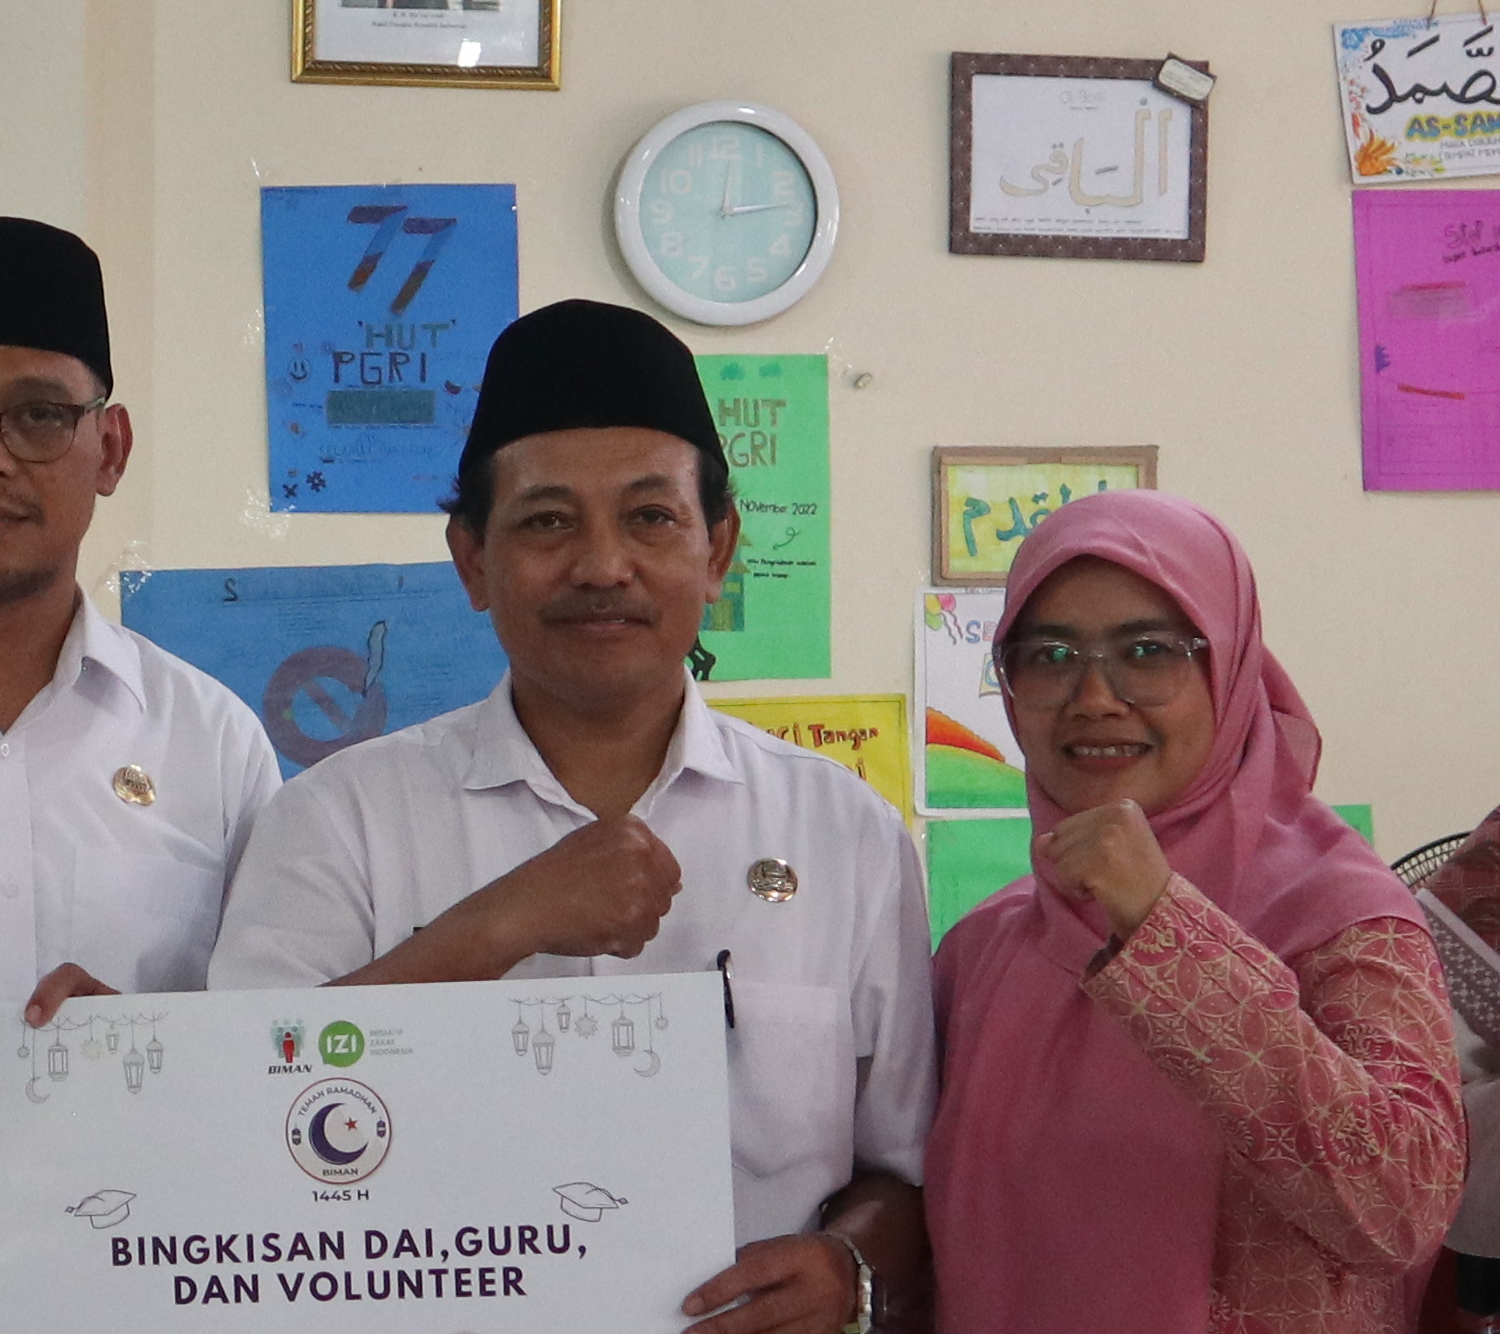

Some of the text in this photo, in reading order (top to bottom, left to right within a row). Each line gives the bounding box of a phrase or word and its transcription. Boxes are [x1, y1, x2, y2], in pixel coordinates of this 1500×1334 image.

[660, 168, 692, 195] 10
[772, 171, 795, 195] 2
[651, 200, 674, 224] 9
[660, 232, 683, 257] 8
[769, 234, 791, 257] 4
[347, 204, 458, 315] 77
[687, 256, 711, 280] 7
[747, 257, 768, 283] 5
[714, 266, 737, 291] 6
[333, 351, 427, 386] PGRI
[718, 397, 787, 427] HUT
[792, 503, 817, 516] 2022
[808, 723, 879, 750] Tangan
[326, 1033, 357, 1055] IZI
[267, 1064, 313, 1075] BIMAN
[326, 1087, 378, 1115] RAMADHAN
[322, 1168, 359, 1177] BIMAN
[311, 1189, 369, 1203] 1445 H
[111, 1231, 346, 1267] BINGKISAN
[173, 1266, 528, 1305] DAN VOLUNTEER
